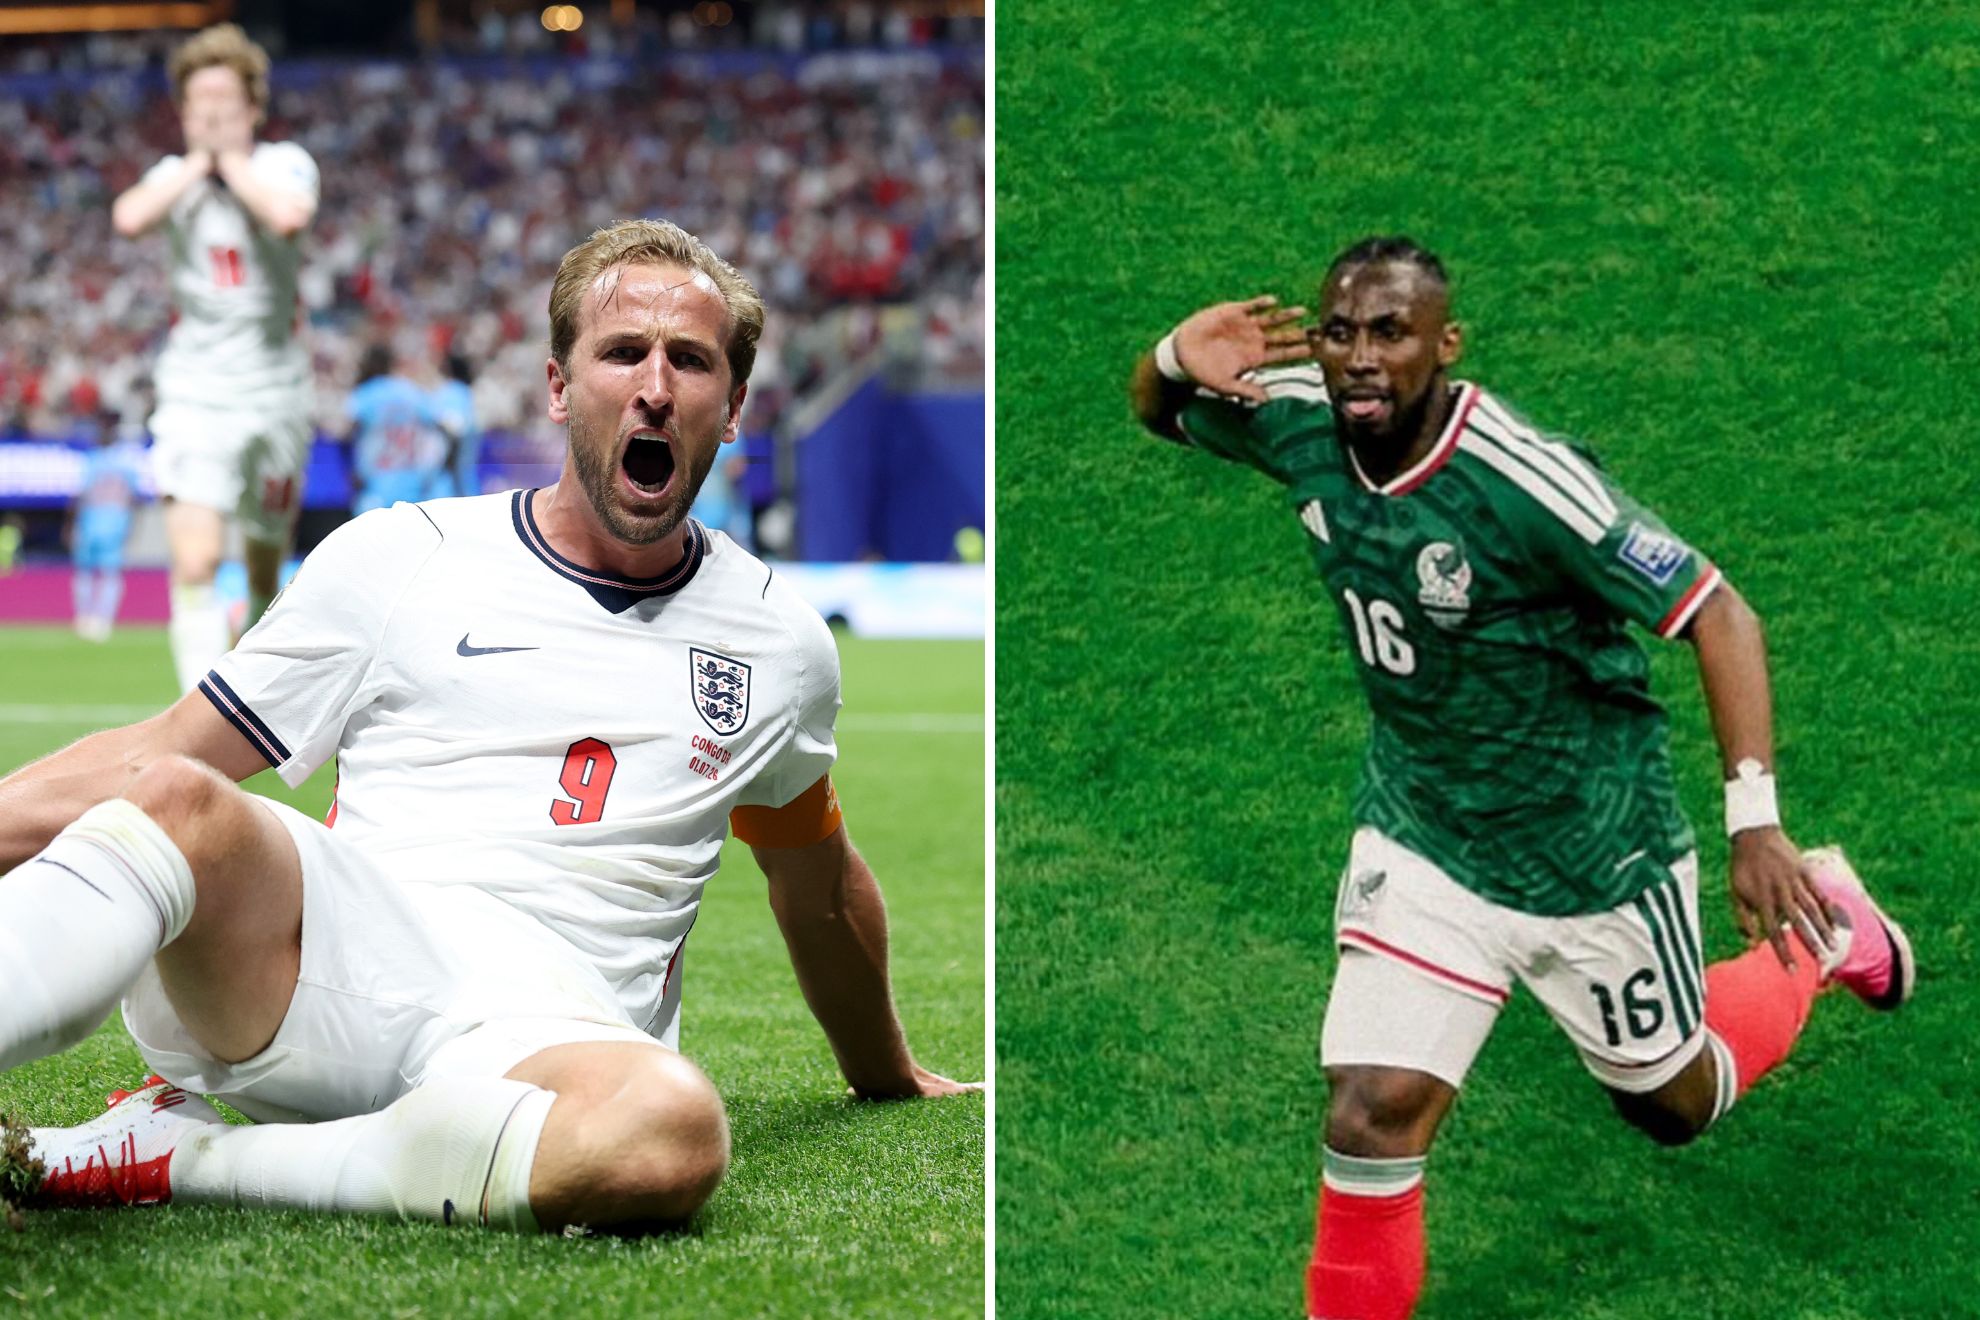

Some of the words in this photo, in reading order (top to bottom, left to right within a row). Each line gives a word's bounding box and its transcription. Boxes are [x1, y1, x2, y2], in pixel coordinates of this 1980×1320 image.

[1343, 587, 1415, 675] 16
[549, 736, 617, 825] 9
[688, 756, 719, 781] 01.07.26
[691, 734, 723, 760] CONGO
[720, 749, 732, 766] DR
[1590, 967, 1664, 1047] 16
